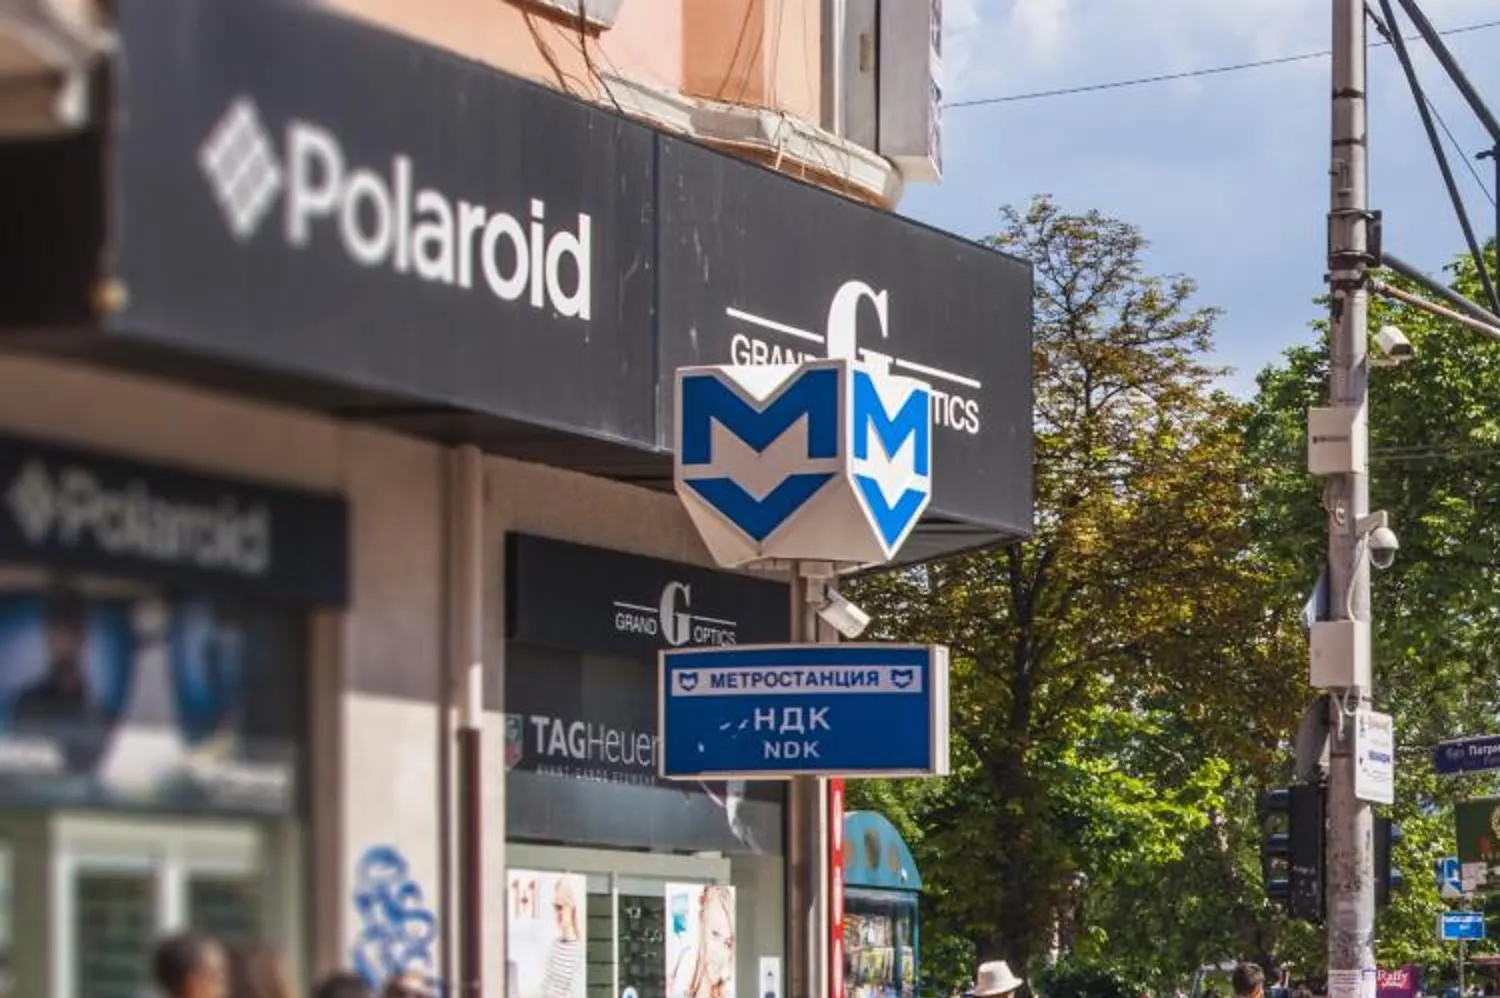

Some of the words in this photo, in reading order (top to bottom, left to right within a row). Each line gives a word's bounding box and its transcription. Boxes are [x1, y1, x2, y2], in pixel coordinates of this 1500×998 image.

[285, 123, 591, 320] Polaroid
[57, 468, 271, 573] Polaroid
[614, 612, 658, 635] GRAND
[694, 625, 736, 645] OPTICS
[710, 670, 879, 689] МЕТРОСТАНЦИЯ
[754, 706, 831, 734] НДК
[763, 740, 820, 759] NDK
